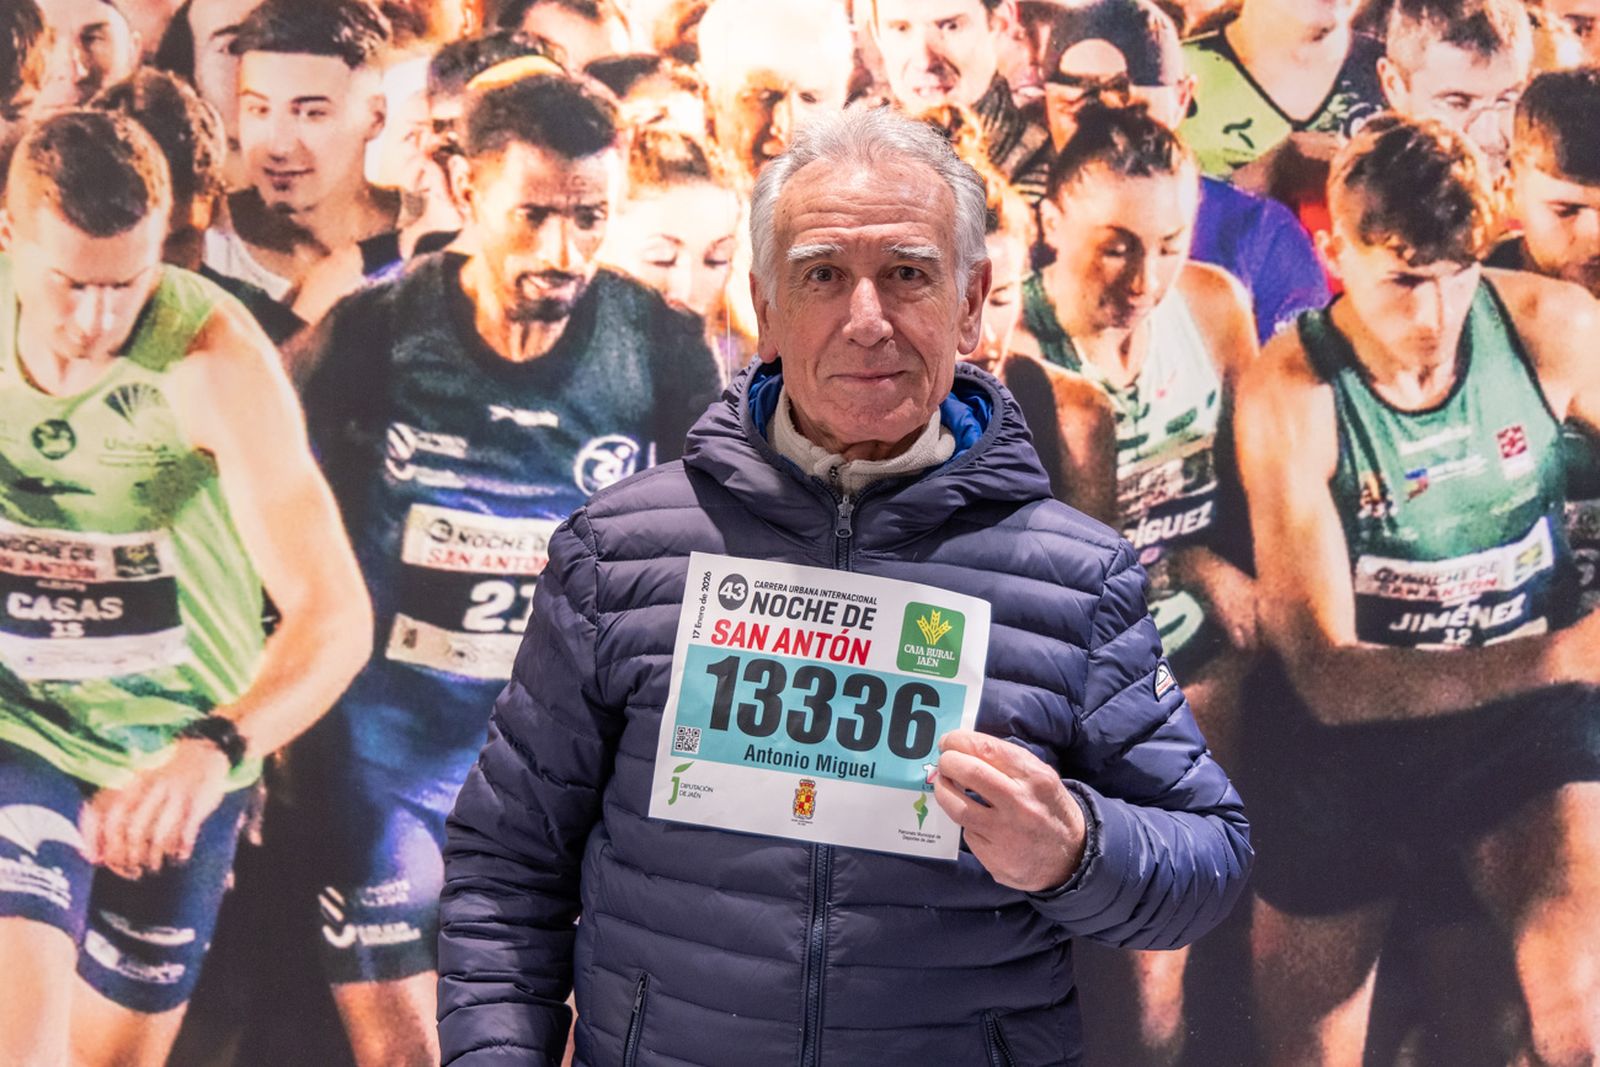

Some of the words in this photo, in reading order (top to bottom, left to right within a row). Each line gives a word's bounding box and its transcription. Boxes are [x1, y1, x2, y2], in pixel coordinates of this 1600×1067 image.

[533, 533, 547, 551] D
[701, 571, 712, 592] 2026
[719, 581, 747, 601] 43
[699, 594, 708, 605] de
[754, 580, 788, 592] CARRERA
[788, 585, 819, 597] URBANA
[819, 589, 877, 606] INTERNACIONAL
[7, 591, 124, 621] CASAS
[695, 606, 705, 628] Enero
[749, 591, 838, 625] NOCHE
[841, 604, 877, 631] DE
[692, 630, 701, 639] 17
[711, 619, 770, 651] SAN
[771, 628, 872, 666] ANTÓN
[904, 643, 925, 656] CAJA
[926, 647, 955, 660] RURAL
[706, 655, 940, 760] 13336
[743, 744, 810, 770] Antonio
[816, 753, 876, 779] Miguel
